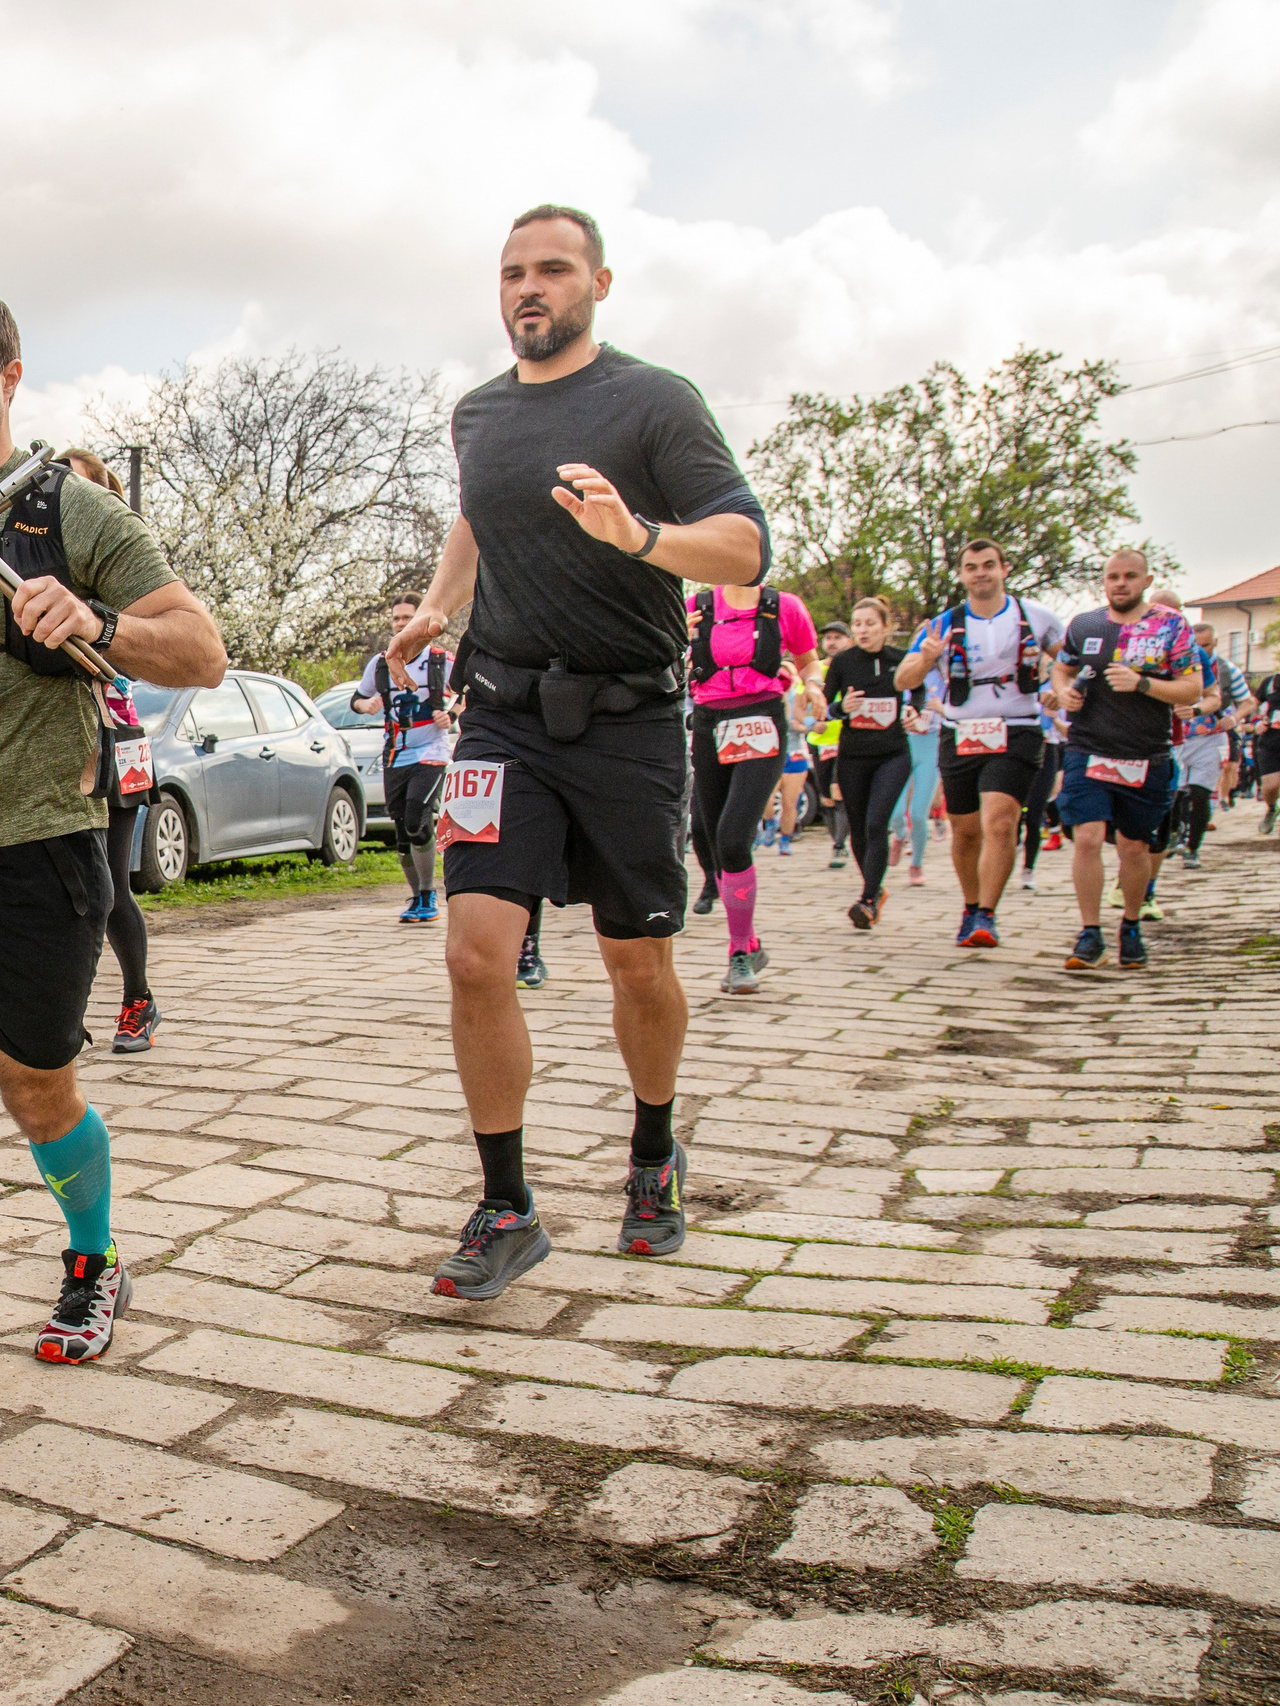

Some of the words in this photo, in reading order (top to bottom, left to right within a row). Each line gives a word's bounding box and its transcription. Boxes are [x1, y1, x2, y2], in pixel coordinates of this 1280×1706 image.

[14, 521, 48, 535] EVADICT
[474, 671, 497, 692] KIPRUN
[736, 721, 772, 738] 2380
[444, 768, 498, 803] 2167
